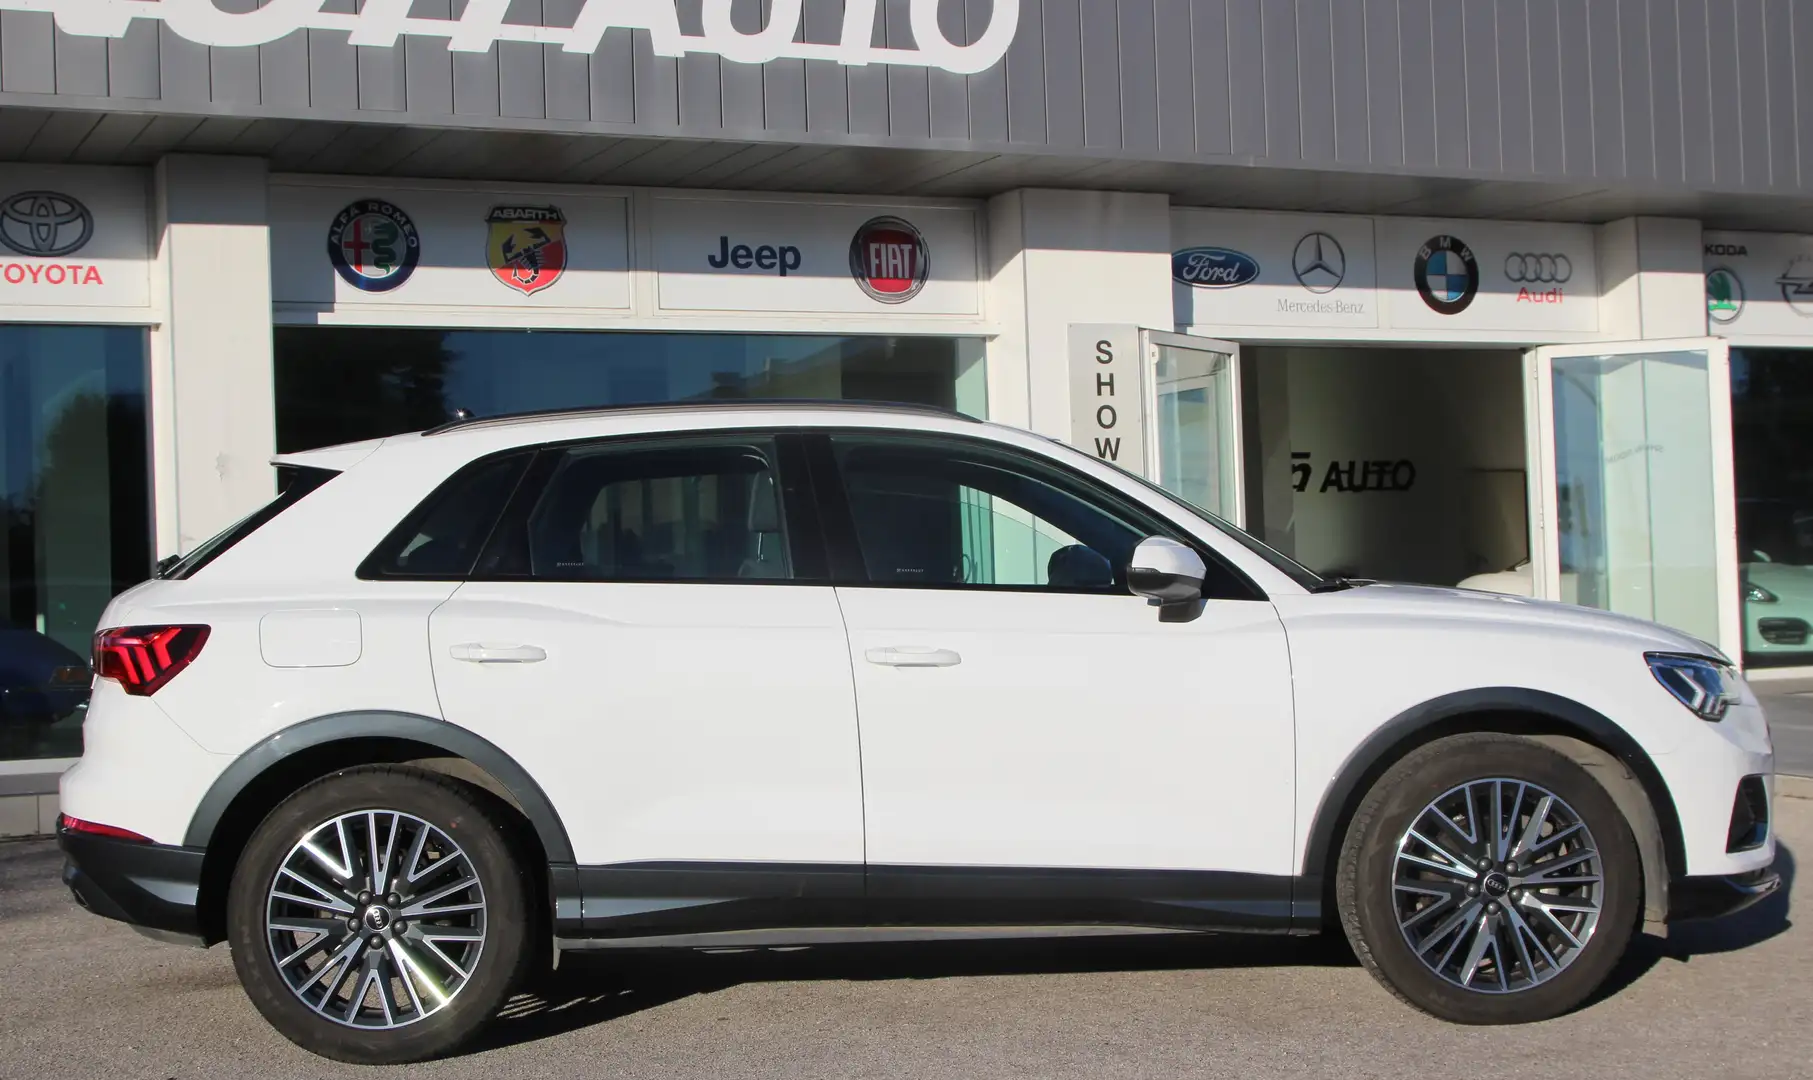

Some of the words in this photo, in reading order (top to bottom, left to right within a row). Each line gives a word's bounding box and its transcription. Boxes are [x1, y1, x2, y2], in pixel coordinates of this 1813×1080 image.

[331, 206, 362, 245] ALFA
[368, 202, 418, 248] ROMEO
[493, 208, 558, 220] ABARTH
[707, 236, 801, 277] Jeep
[869, 243, 913, 279] FIAT
[1419, 236, 1473, 262] BMW
[0, 263, 104, 285] OYOTA
[1182, 253, 1240, 282] Ford
[1277, 299, 1365, 315] Mercedes-Benz
[1516, 287, 1564, 304] Audi
[1094, 339, 1121, 461] SHOW
[1319, 459, 1416, 493] AUTO
